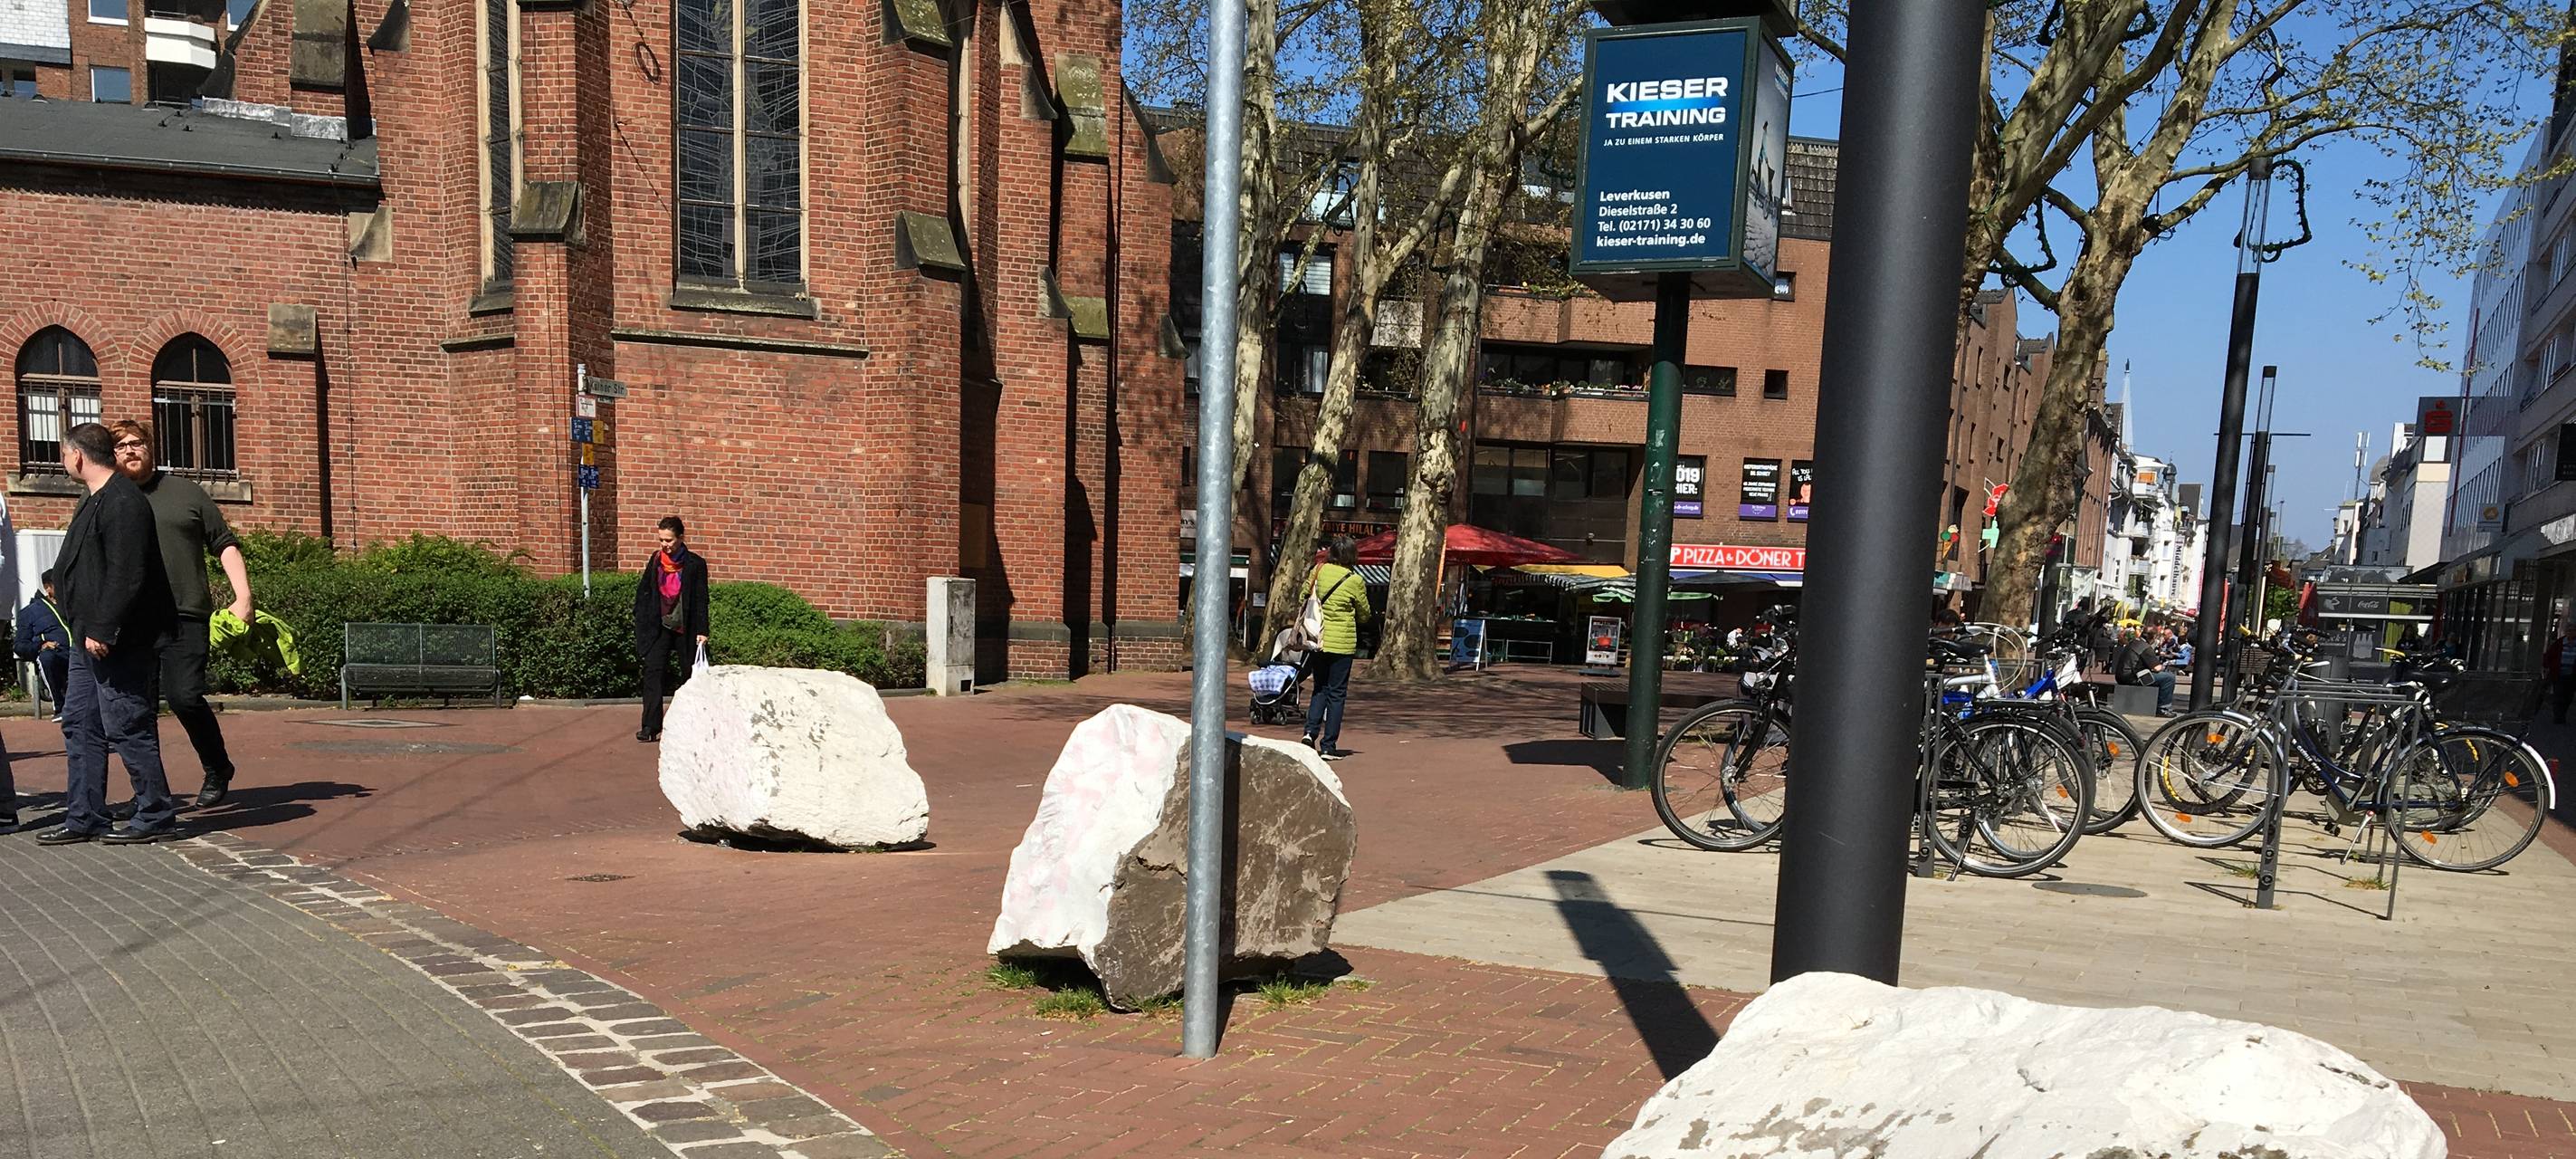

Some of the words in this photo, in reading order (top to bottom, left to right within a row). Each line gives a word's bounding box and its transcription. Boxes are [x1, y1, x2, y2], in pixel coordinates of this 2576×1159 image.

[1607, 76, 1729, 103] KIESER
[1606, 107, 1726, 129] TRAINING
[1603, 139, 1613, 147] JA
[1615, 138, 1626, 146] ZU
[1627, 136, 1653, 146] EINEM
[1655, 134, 1690, 144] STARKEN
[1693, 132, 1724, 142] KÖRPER
[1599, 189, 1671, 202] Leverkusen
[1598, 204, 1668, 216] Dieselstraße
[1670, 204, 1678, 215] 2
[1598, 220, 1617, 232] Tel.
[1618, 218, 1661, 233] (02171)
[1663, 218, 1677, 230] 34
[1679, 218, 1694, 229] 30
[1696, 217, 1712, 229] 60
[1596, 233, 1706, 247] kieser-training.de
[1675, 467, 1701, 483] 019
[1670, 547, 1682, 563] P
[1684, 547, 1725, 565] PIZZA
[1726, 552, 1734, 562] &
[1735, 549, 1792, 567] DÖNER
[1796, 551, 1806, 567] T
